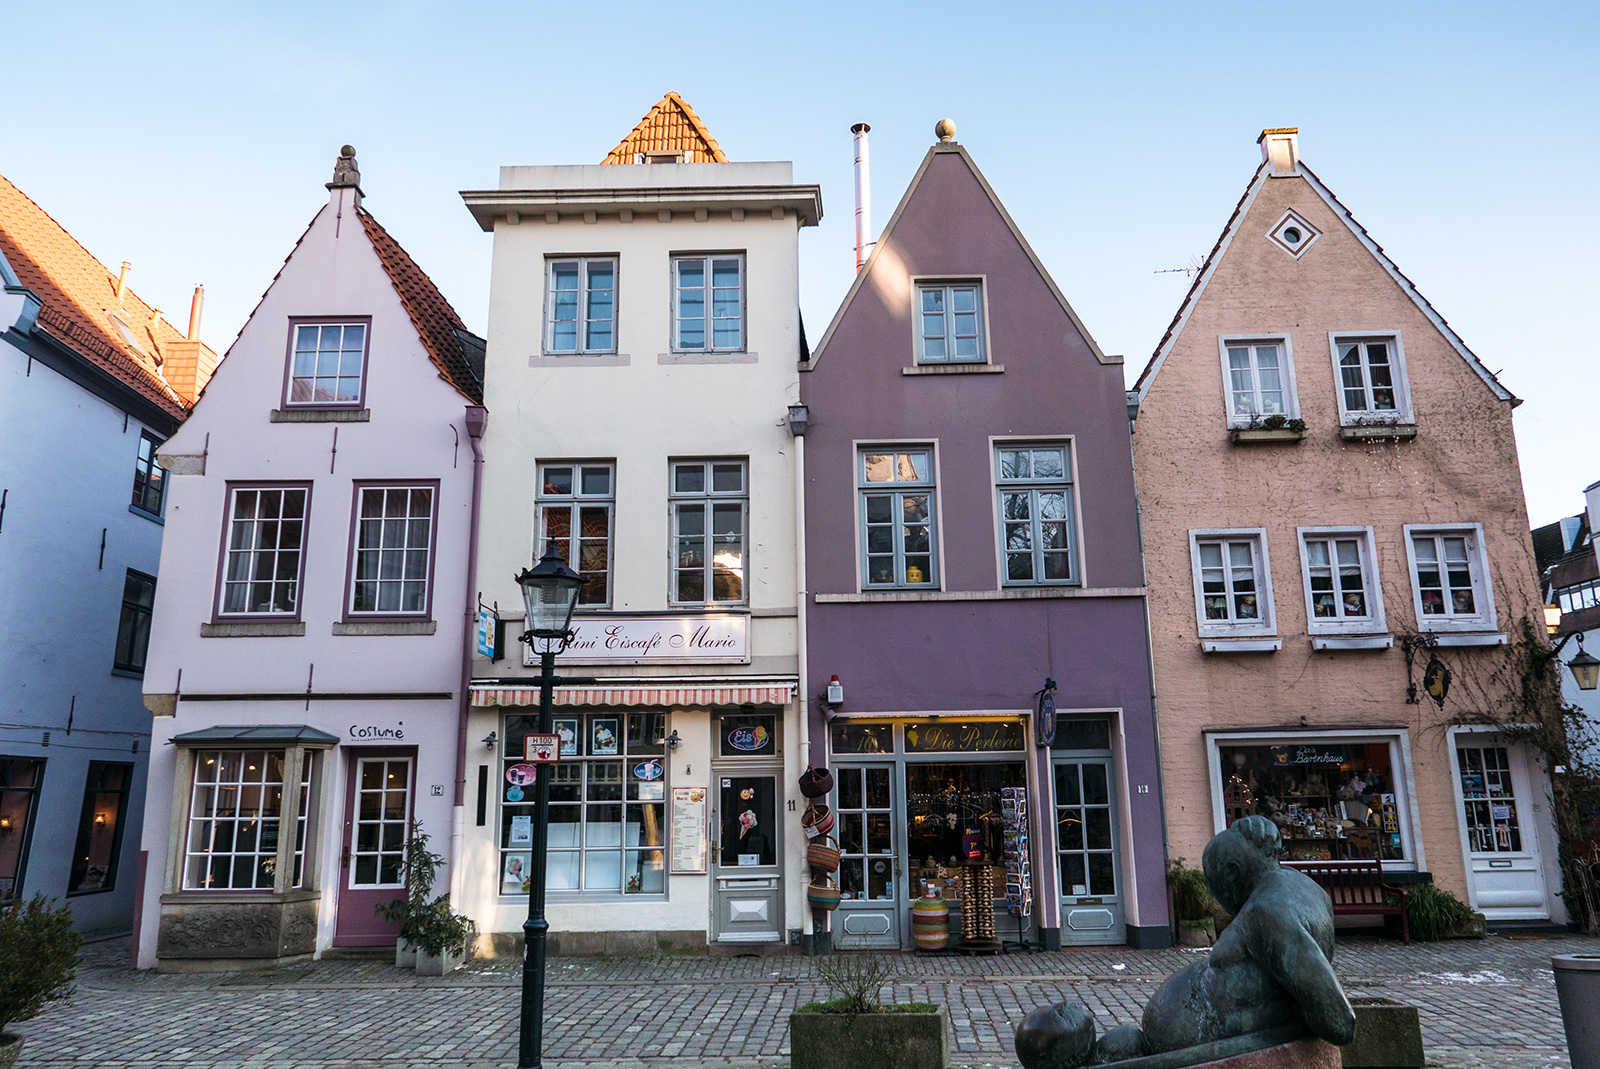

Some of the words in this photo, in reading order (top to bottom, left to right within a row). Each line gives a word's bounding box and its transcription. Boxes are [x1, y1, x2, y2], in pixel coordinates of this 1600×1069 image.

[604, 625, 661, 656] Eiscafé
[668, 625, 738, 649] Mario
[733, 730, 752, 743] Eis
[924, 726, 955, 751] Die
[959, 726, 1021, 751] Perlerie
[1296, 746, 1316, 754] Das
[433, 786, 442, 794] 12
[786, 799, 796, 811] 11
